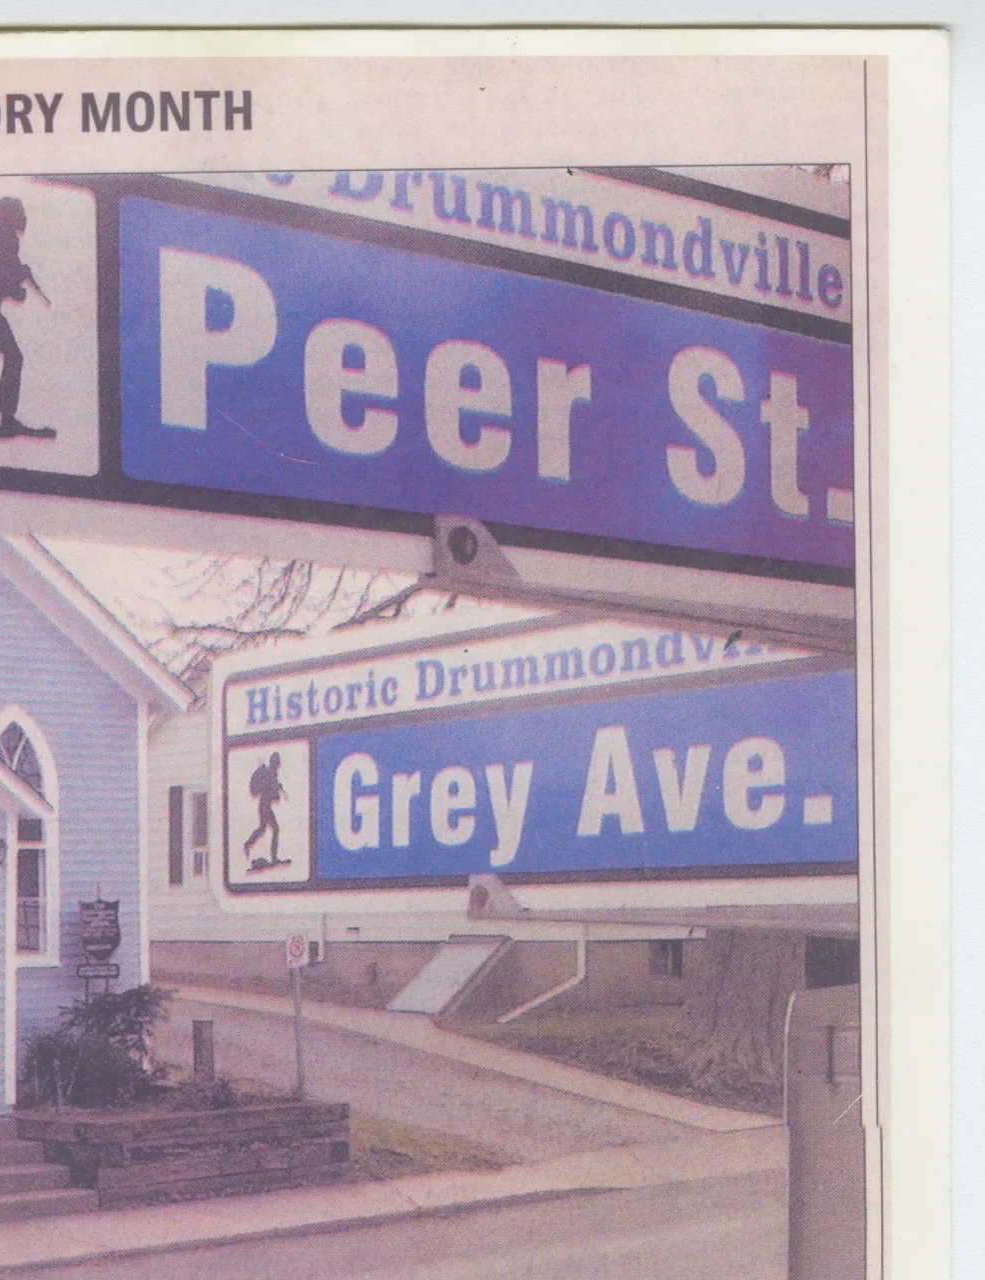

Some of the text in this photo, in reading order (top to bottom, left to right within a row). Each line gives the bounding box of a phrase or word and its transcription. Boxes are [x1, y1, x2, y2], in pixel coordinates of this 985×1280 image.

[81, 90, 252, 133] MONTH
[159, 246, 854, 526] Peer St.
[244, 633, 770, 726] Historic Drummondv
[332, 725, 834, 867] Grey Ave.
